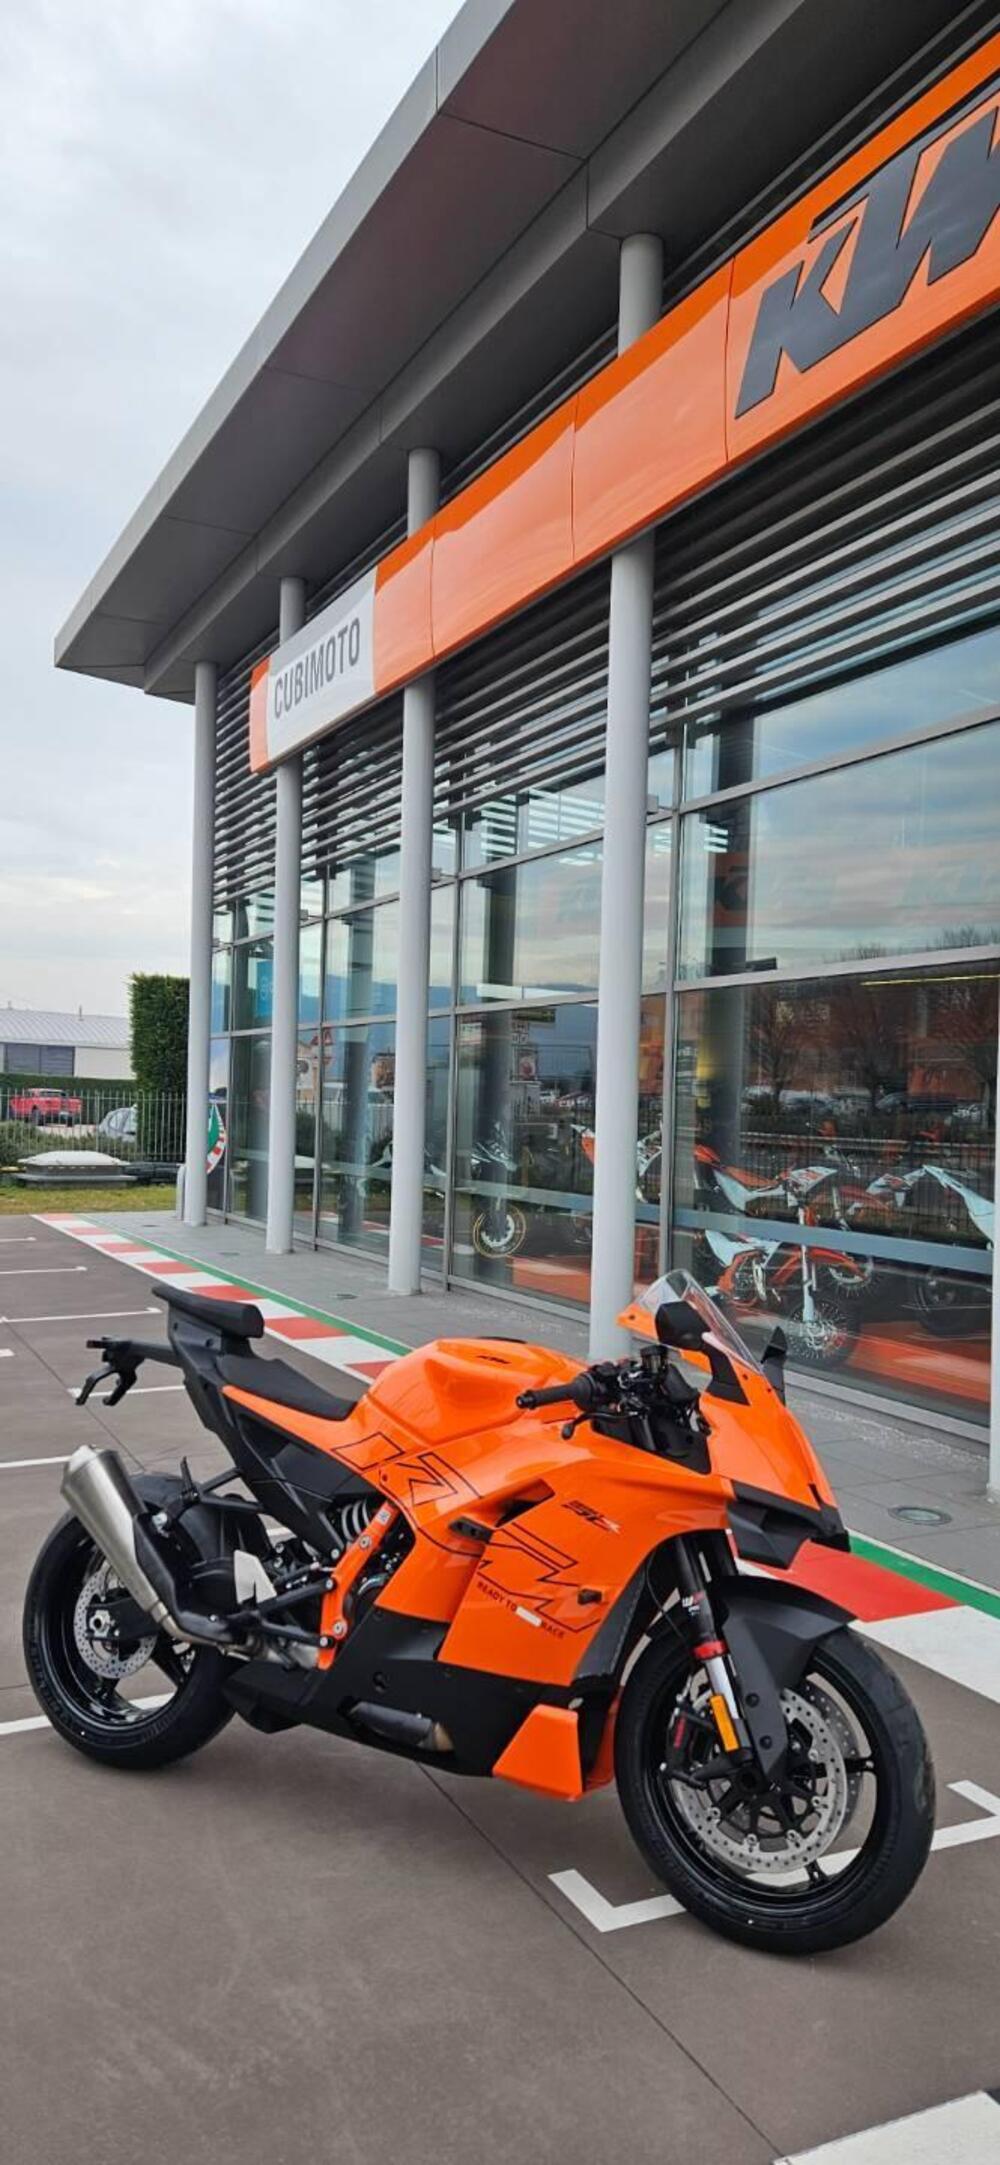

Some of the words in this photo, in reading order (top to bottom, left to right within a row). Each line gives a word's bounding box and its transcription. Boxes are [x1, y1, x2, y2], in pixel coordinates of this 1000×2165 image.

[273, 617, 361, 720] CUBIMOTO
[477, 1581, 505, 1603] READY
[506, 1599, 518, 1613] TO
